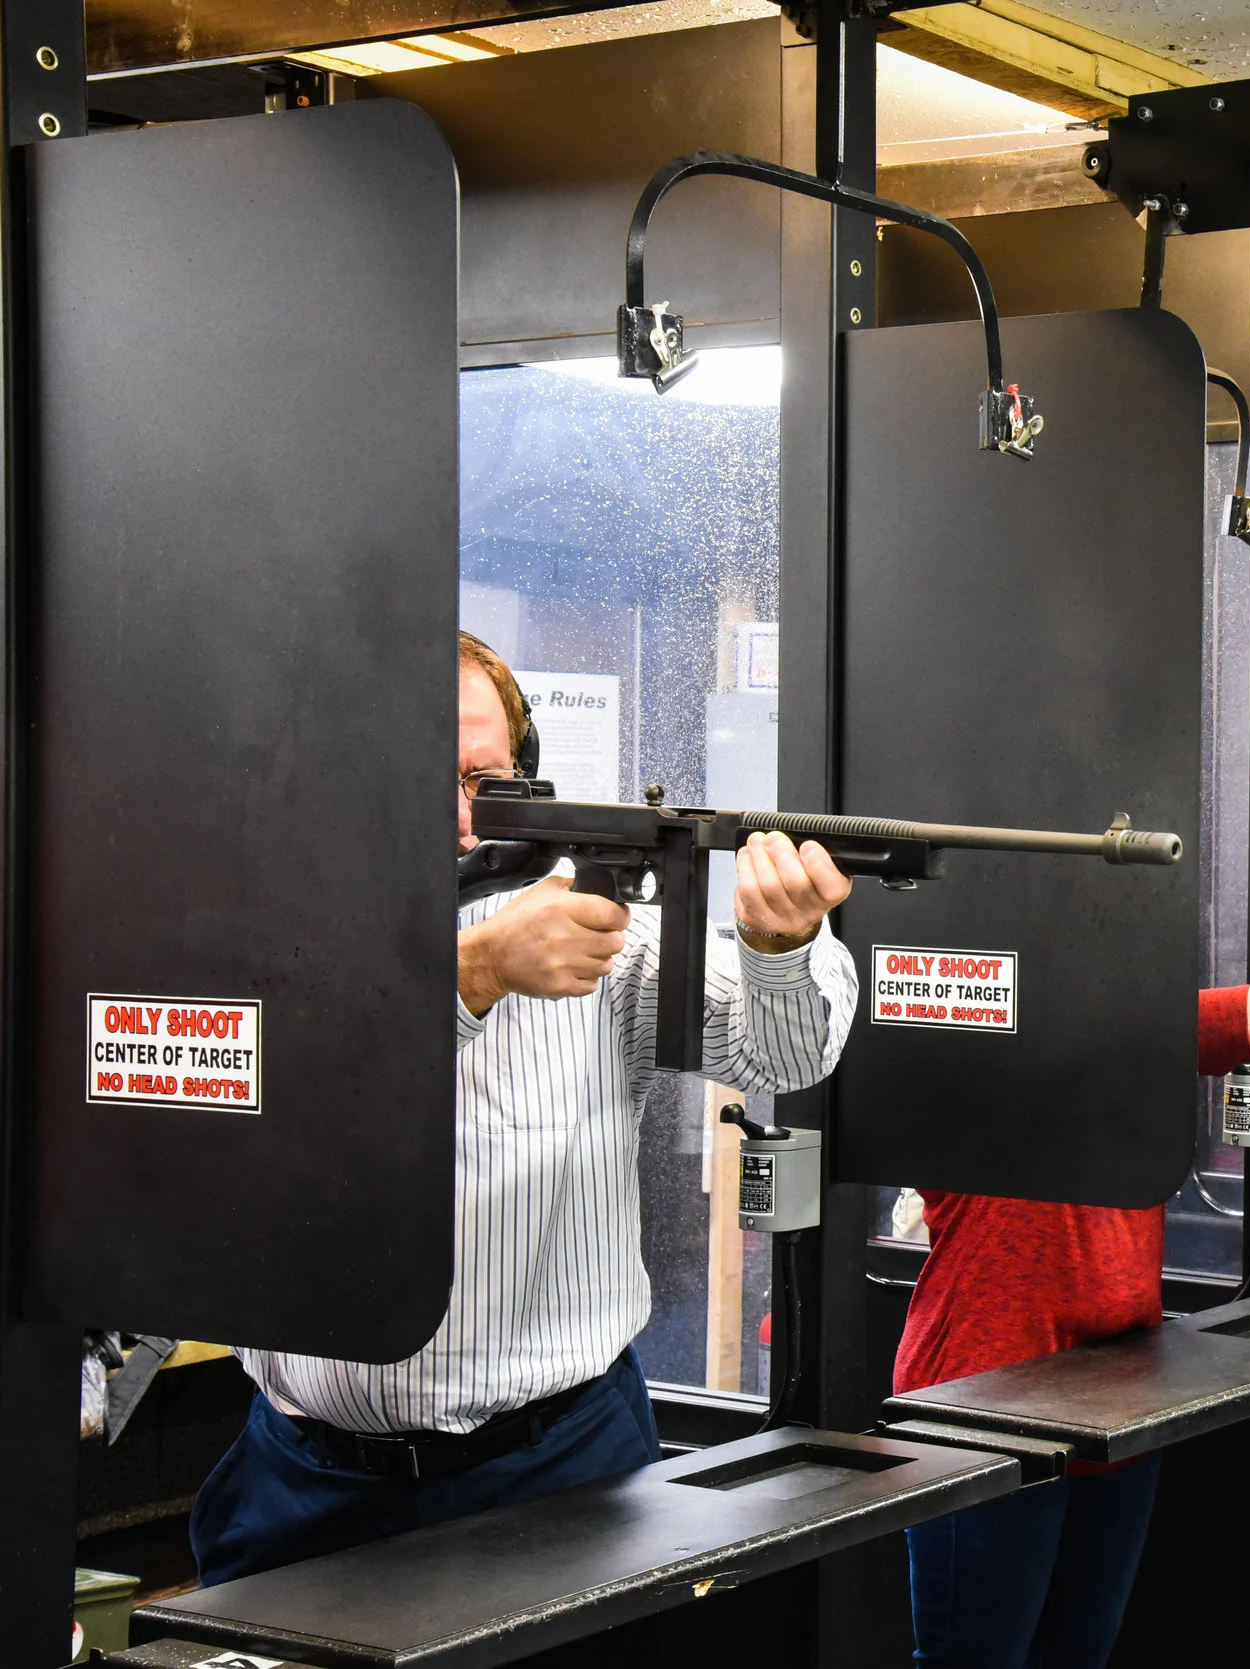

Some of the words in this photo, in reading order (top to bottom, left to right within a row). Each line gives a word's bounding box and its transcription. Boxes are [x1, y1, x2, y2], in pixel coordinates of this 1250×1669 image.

[550, 690, 606, 708] Rules
[886, 954, 935, 976] ONLY
[938, 957, 1002, 980] SHOOT
[878, 980, 930, 997] CENTER
[935, 984, 952, 999] OF
[957, 985, 1010, 1002] TARGET
[104, 1005, 162, 1035] ONLY
[167, 1008, 243, 1039] SHOOT
[880, 1002, 902, 1017] NO
[906, 1004, 947, 1019] HEAD
[951, 1006, 1007, 1024] SHOTS!
[94, 1042, 158, 1065] CENTER
[162, 1045, 184, 1066] OF
[190, 1047, 253, 1070] TARGET
[97, 1072, 124, 1092] NO
[128, 1074, 178, 1094] HEAD
[182, 1077, 250, 1100] SHOTS!
